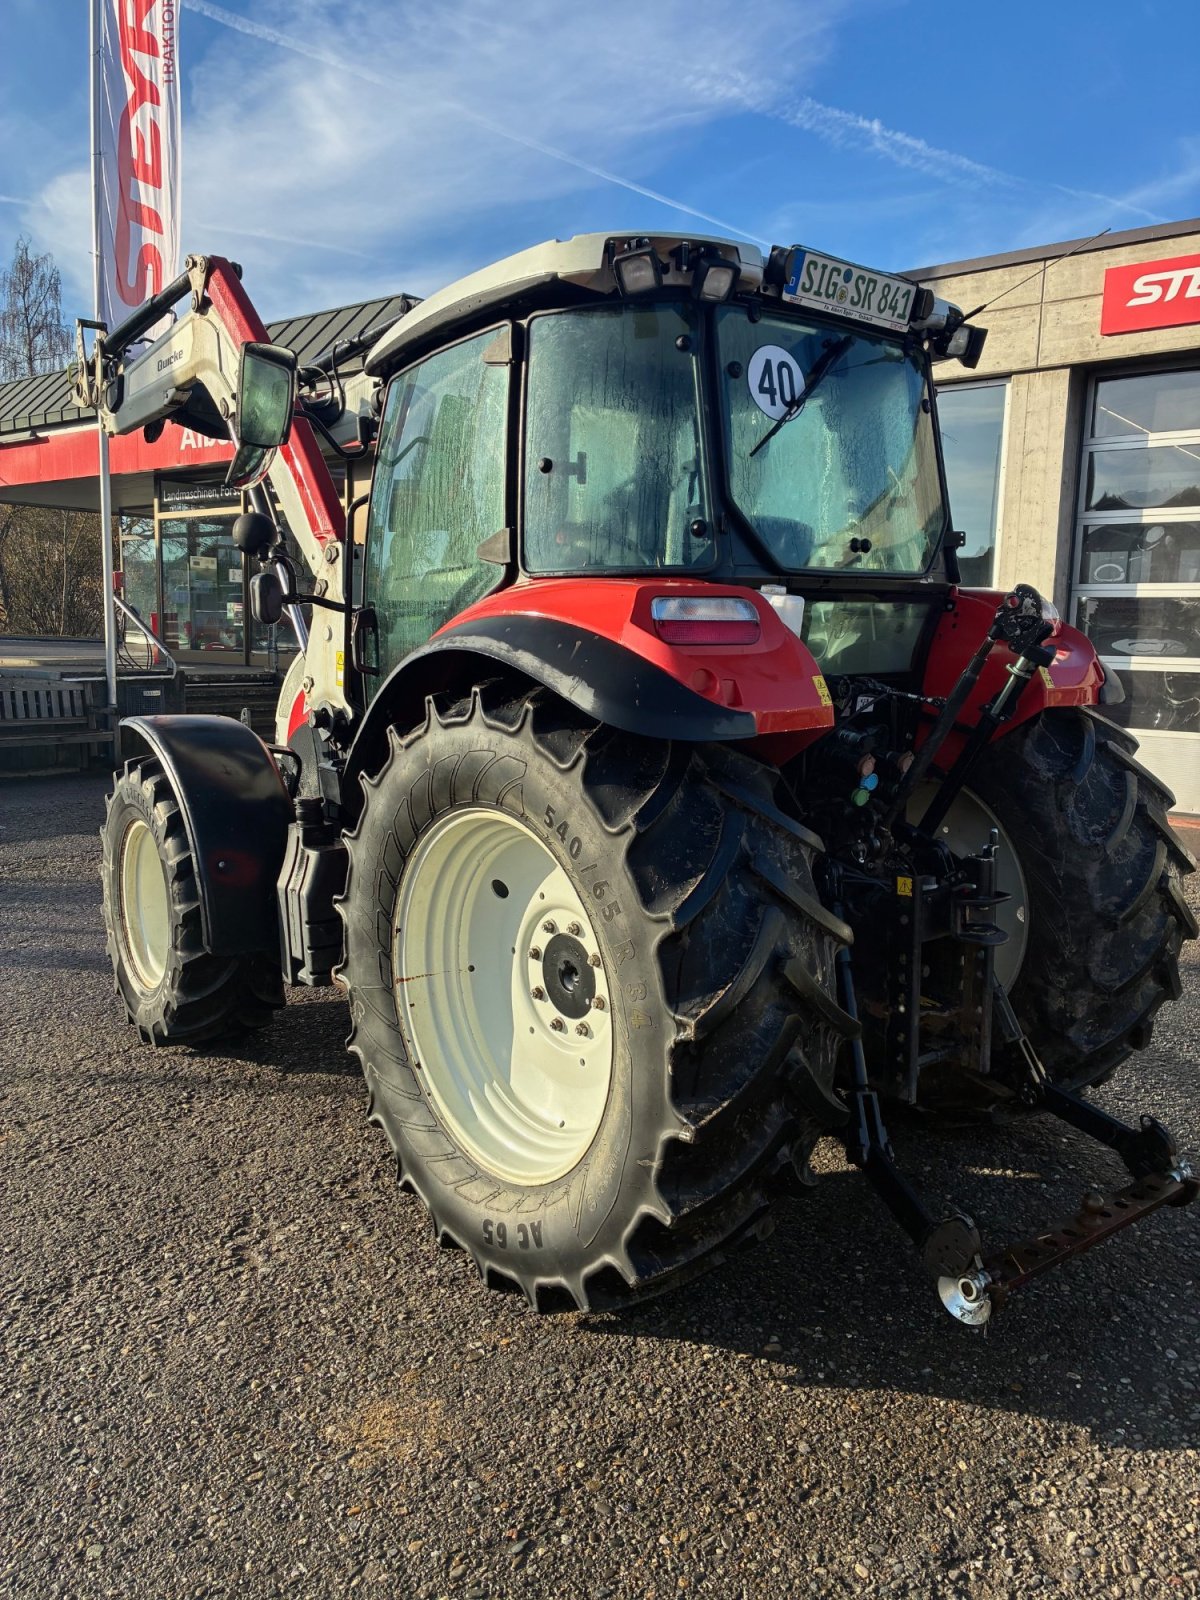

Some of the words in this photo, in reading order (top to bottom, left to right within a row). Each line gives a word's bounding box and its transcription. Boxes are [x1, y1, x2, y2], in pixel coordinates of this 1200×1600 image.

[801, 259, 842, 300] SIG
[850, 274, 878, 311] SR
[877, 281, 912, 321] 841
[157, 349, 184, 372] Quicke
[758, 358, 797, 409] 40
[163, 486, 219, 502] Landmaschinen,
[543, 804, 622, 923] 540/65
[482, 1218, 508, 1249] 65
[517, 1220, 544, 1249] AC
